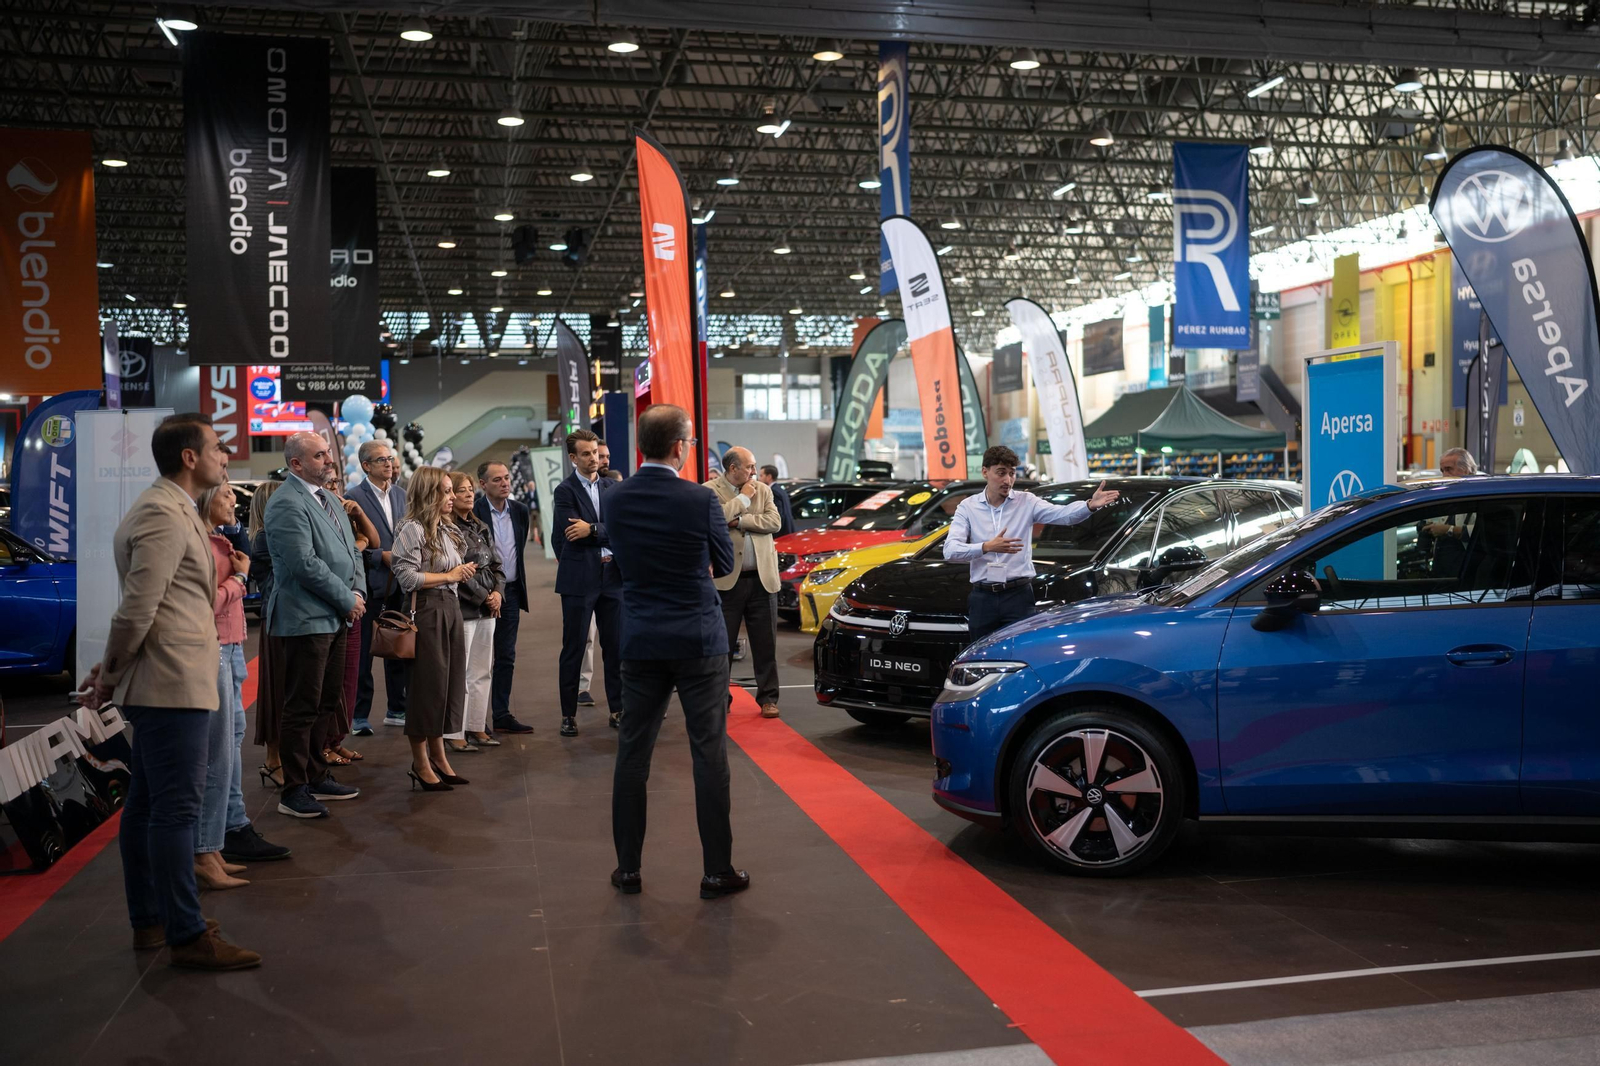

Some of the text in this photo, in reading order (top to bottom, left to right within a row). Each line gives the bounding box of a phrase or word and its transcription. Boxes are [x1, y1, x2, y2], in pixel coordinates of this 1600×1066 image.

[228, 148, 253, 255] blendio
[267, 47, 290, 359] OMODA JAECOO
[17, 211, 61, 370] blendio
[1209, 325, 1247, 336] RUMBAO
[307, 381, 366, 391] 988 661 002
[1320, 411, 1373, 441] Apersa
[48, 452, 72, 560] WIFT
[869, 658, 921, 672] ID.3 NEO
